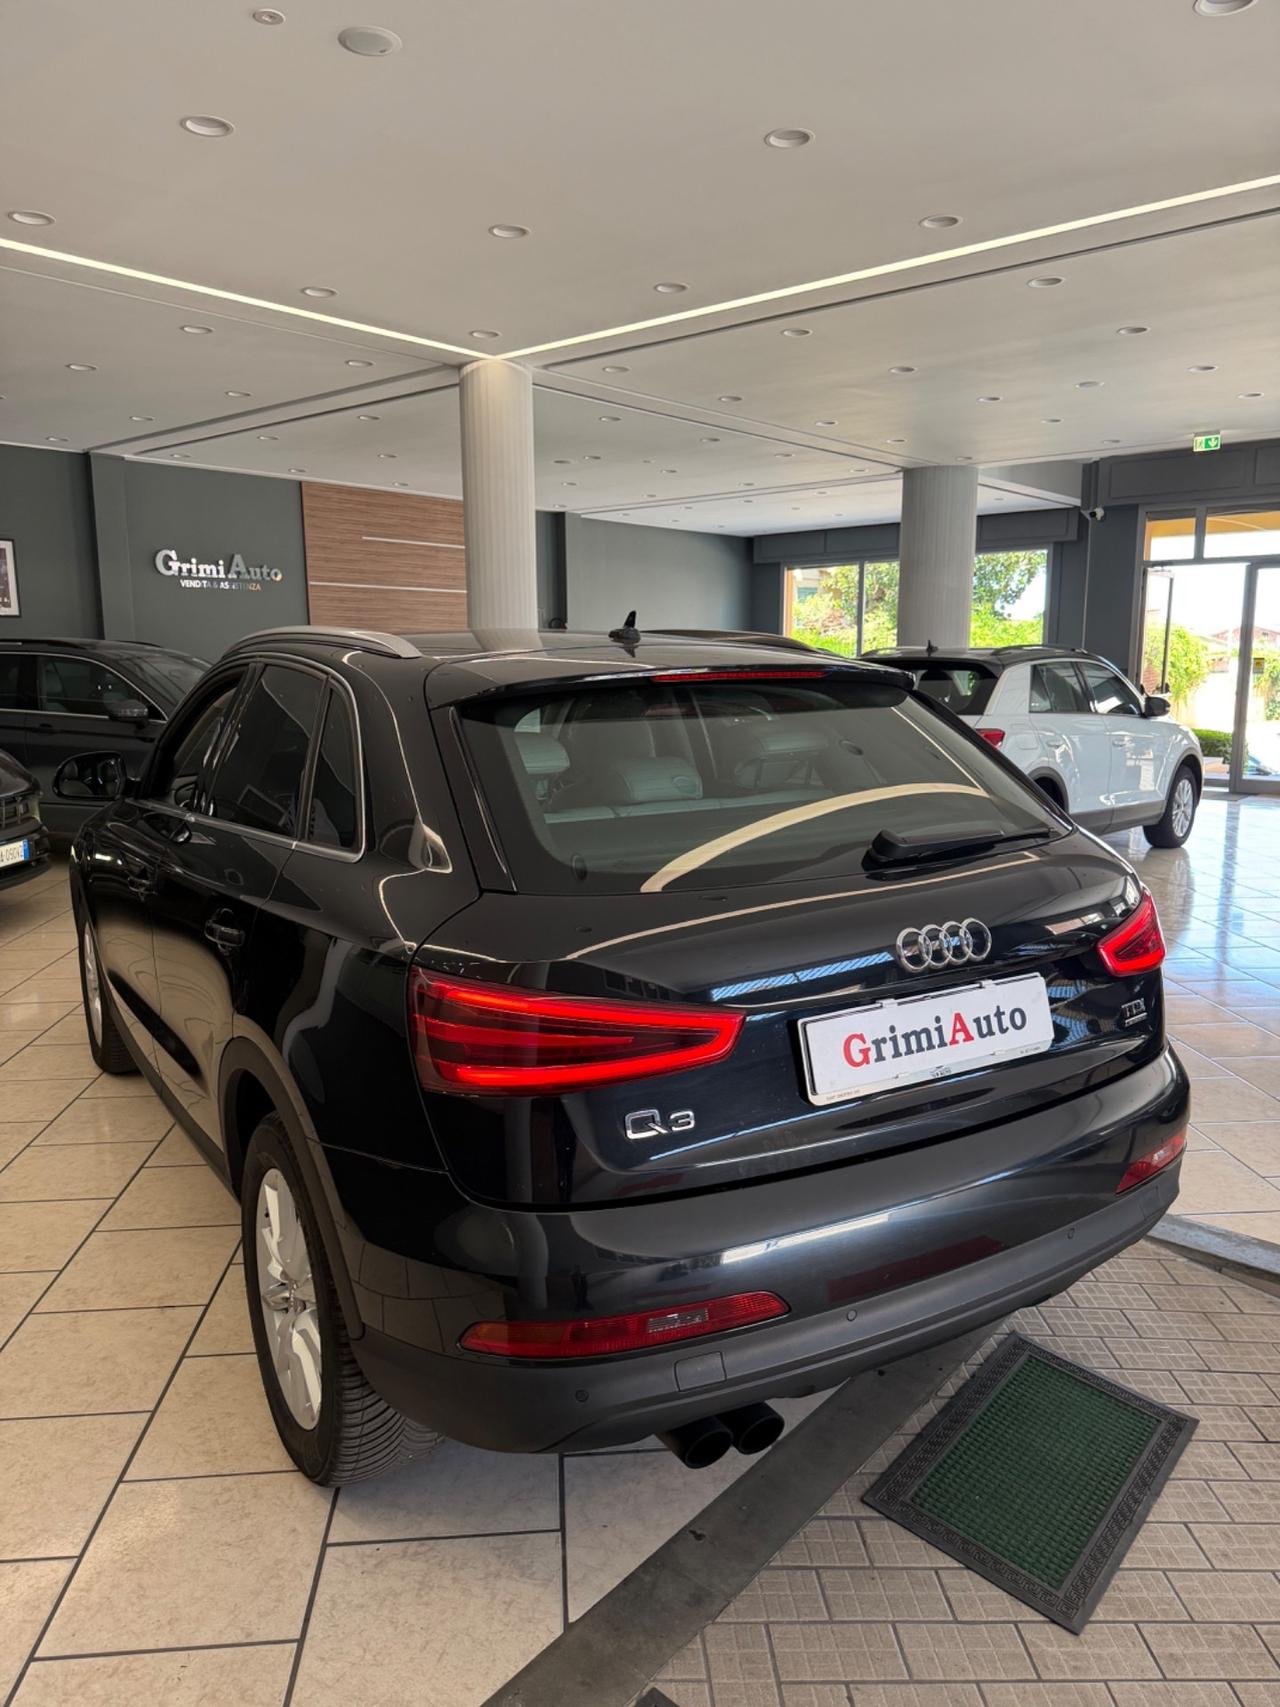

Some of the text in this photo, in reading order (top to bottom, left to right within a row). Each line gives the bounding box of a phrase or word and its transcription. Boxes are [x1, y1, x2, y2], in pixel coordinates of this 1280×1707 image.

[155, 549, 283, 581] Grimi Auto
[843, 1004, 1028, 1068] GrimiAuto
[625, 1109, 695, 1139] Q3
